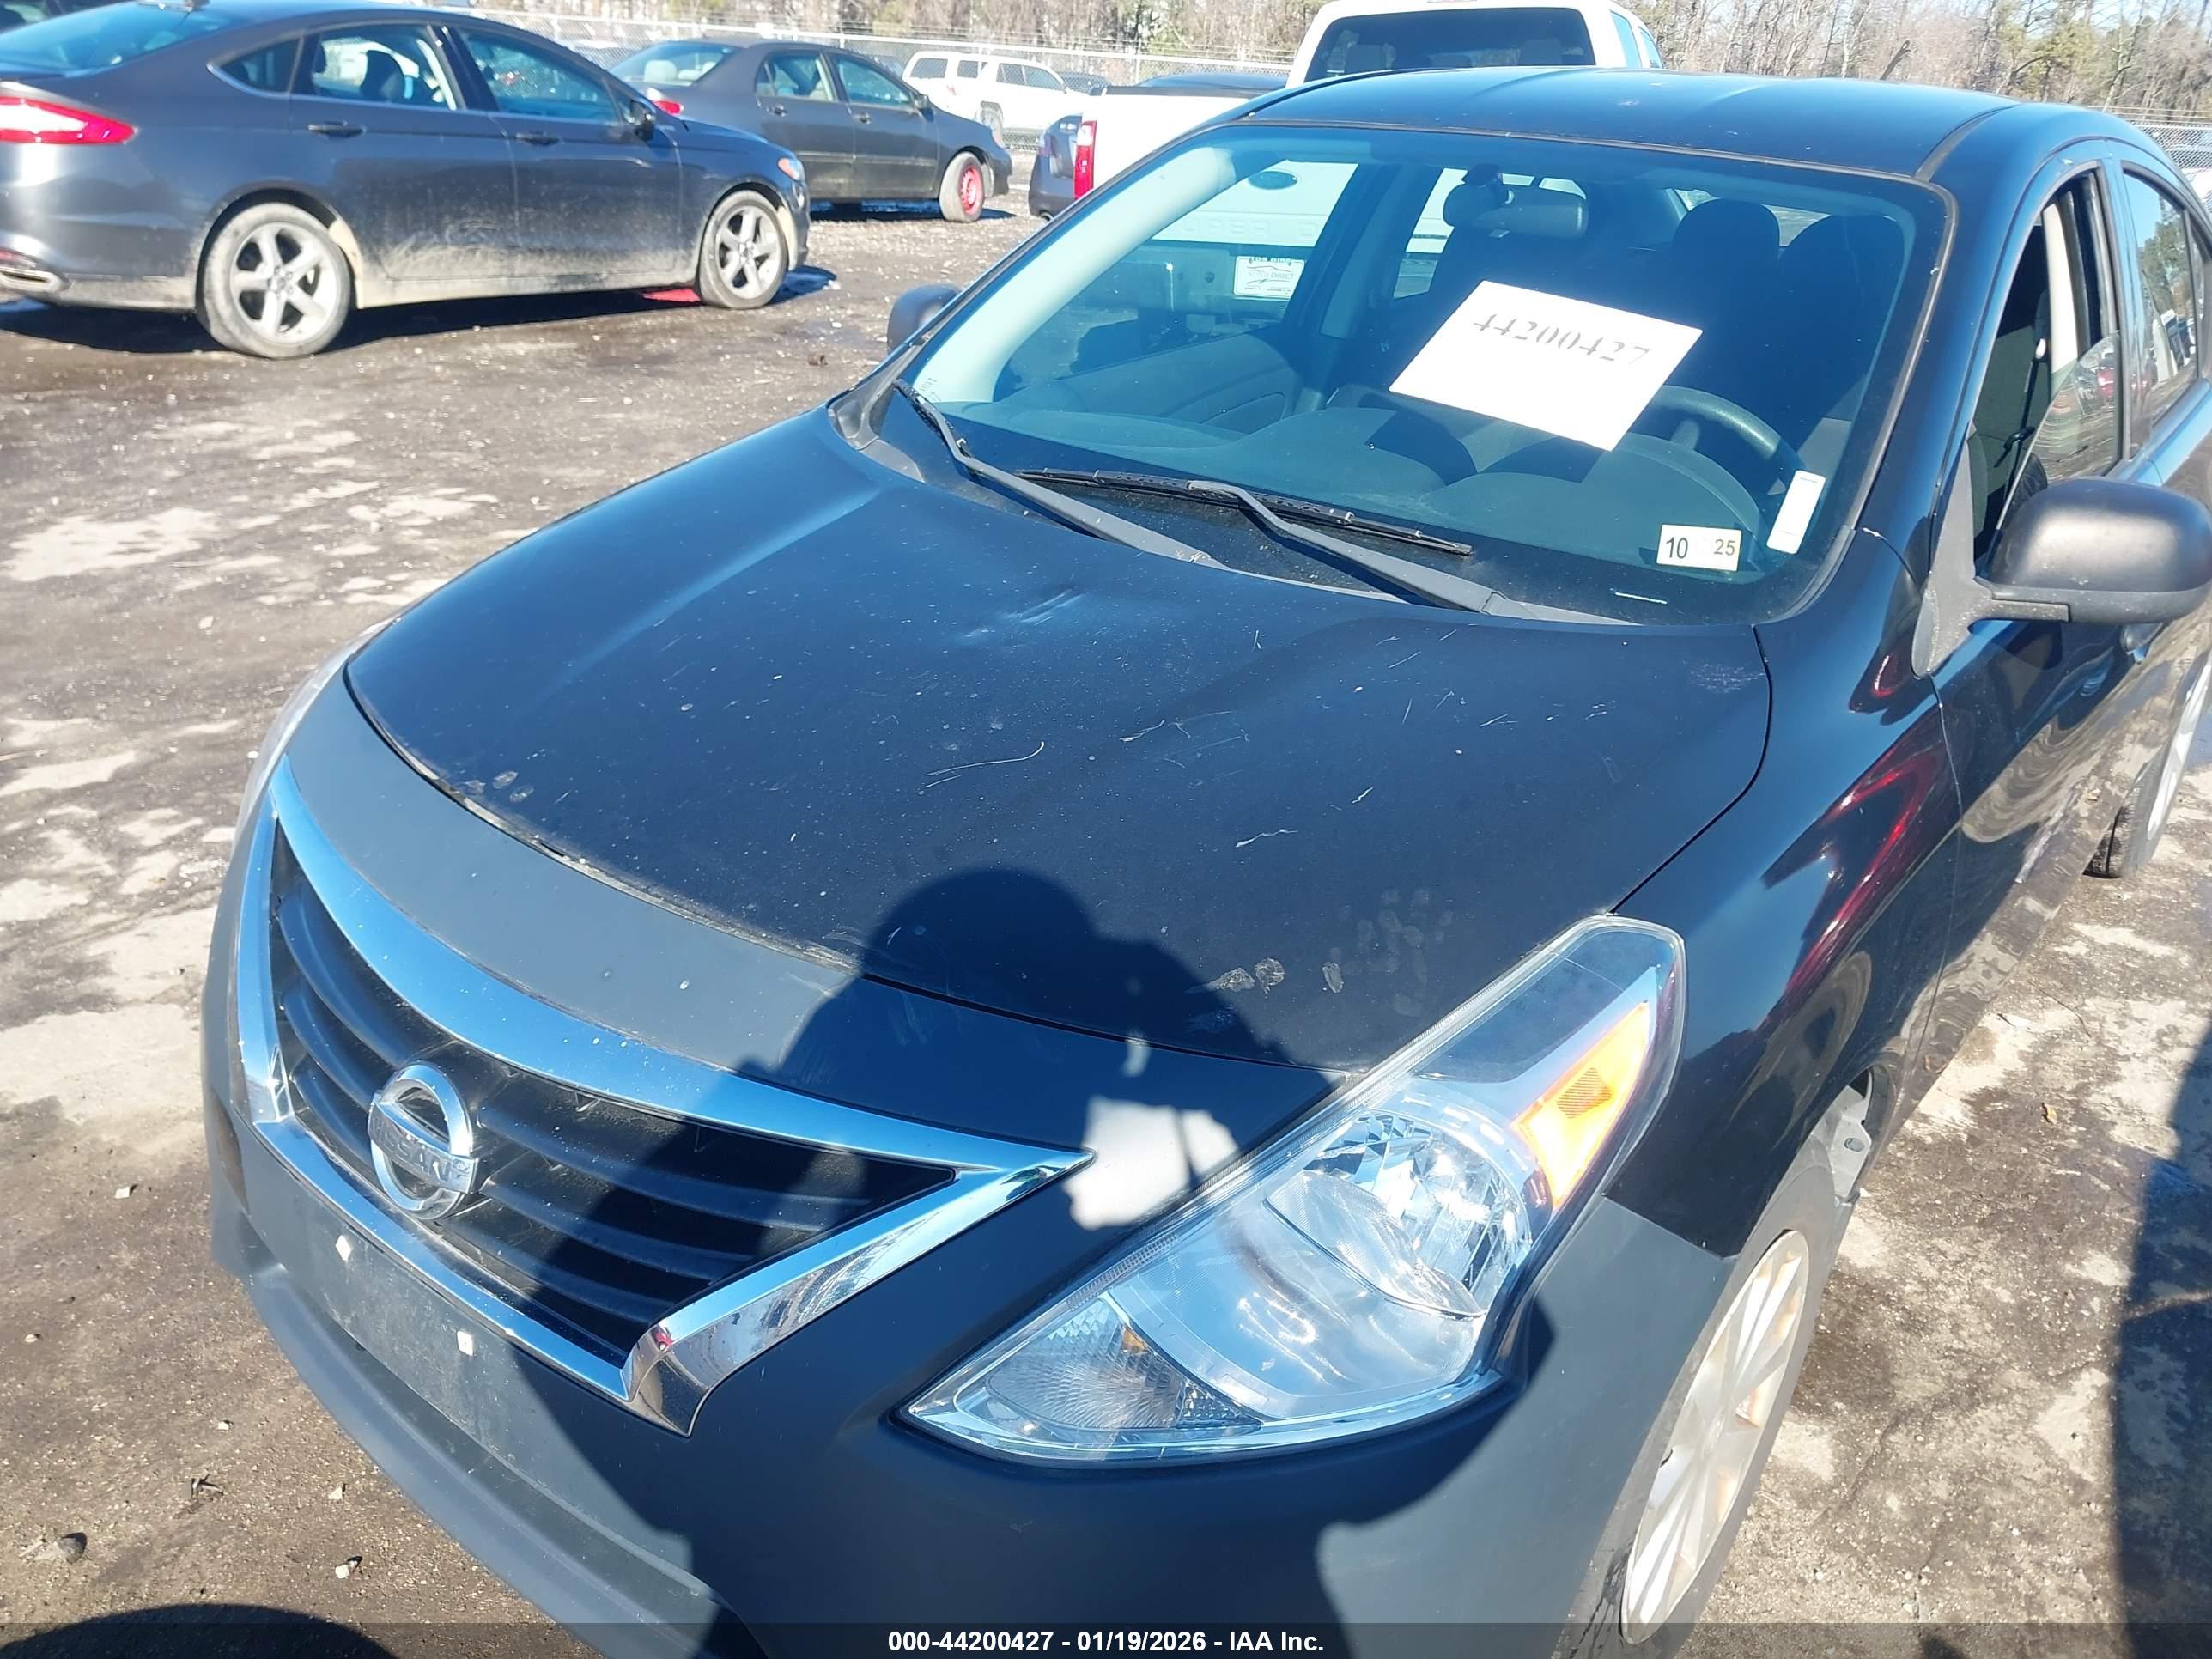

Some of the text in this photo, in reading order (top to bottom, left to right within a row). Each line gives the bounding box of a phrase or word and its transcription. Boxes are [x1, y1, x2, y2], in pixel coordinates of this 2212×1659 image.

[1473, 313, 1652, 365] 44200427
[1666, 536, 1736, 560] 10 25
